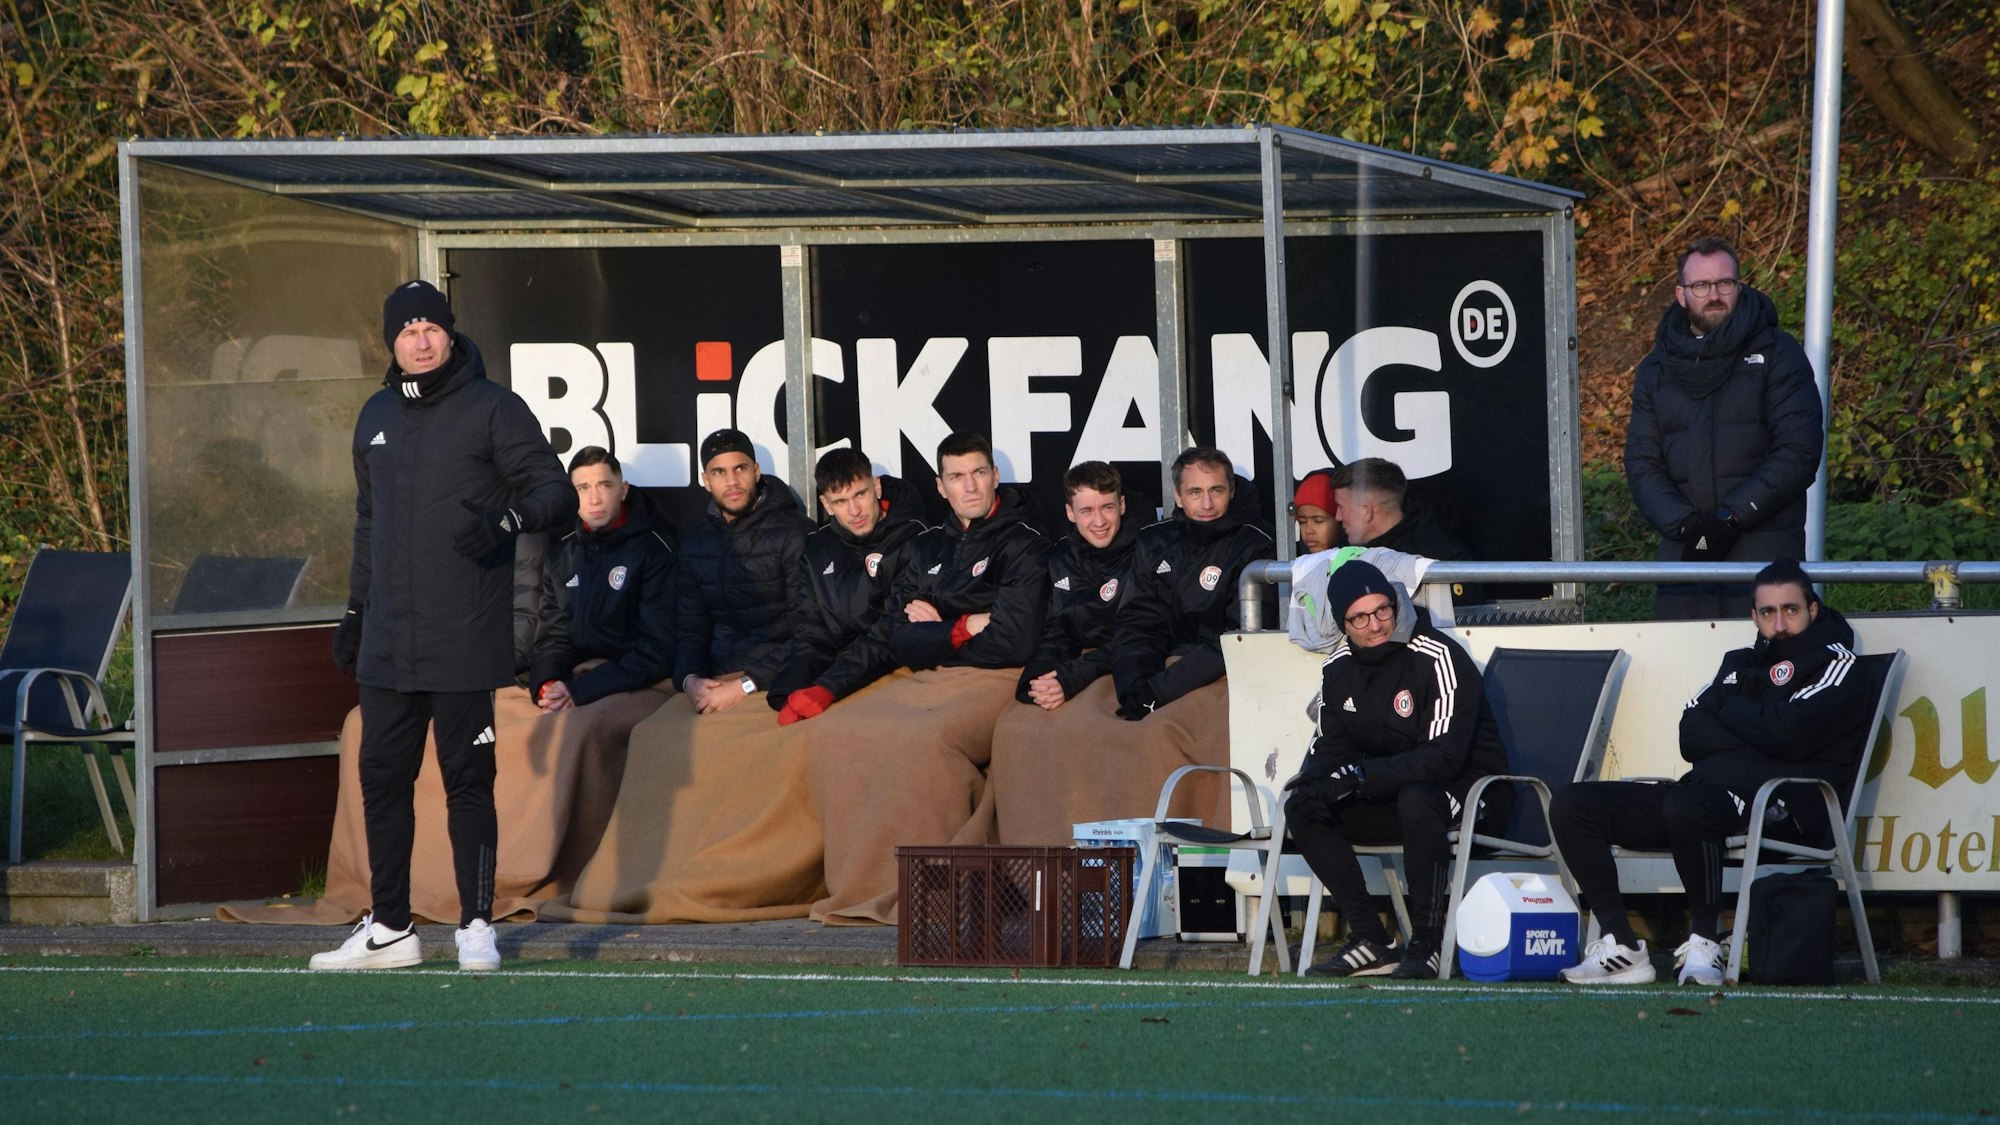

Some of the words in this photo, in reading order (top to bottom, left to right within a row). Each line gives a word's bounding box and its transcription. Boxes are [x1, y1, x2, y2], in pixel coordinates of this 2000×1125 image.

[1462, 307, 1505, 341] DE
[1853, 815, 2000, 874] Hotel
[1526, 930, 1550, 939] SPORT
